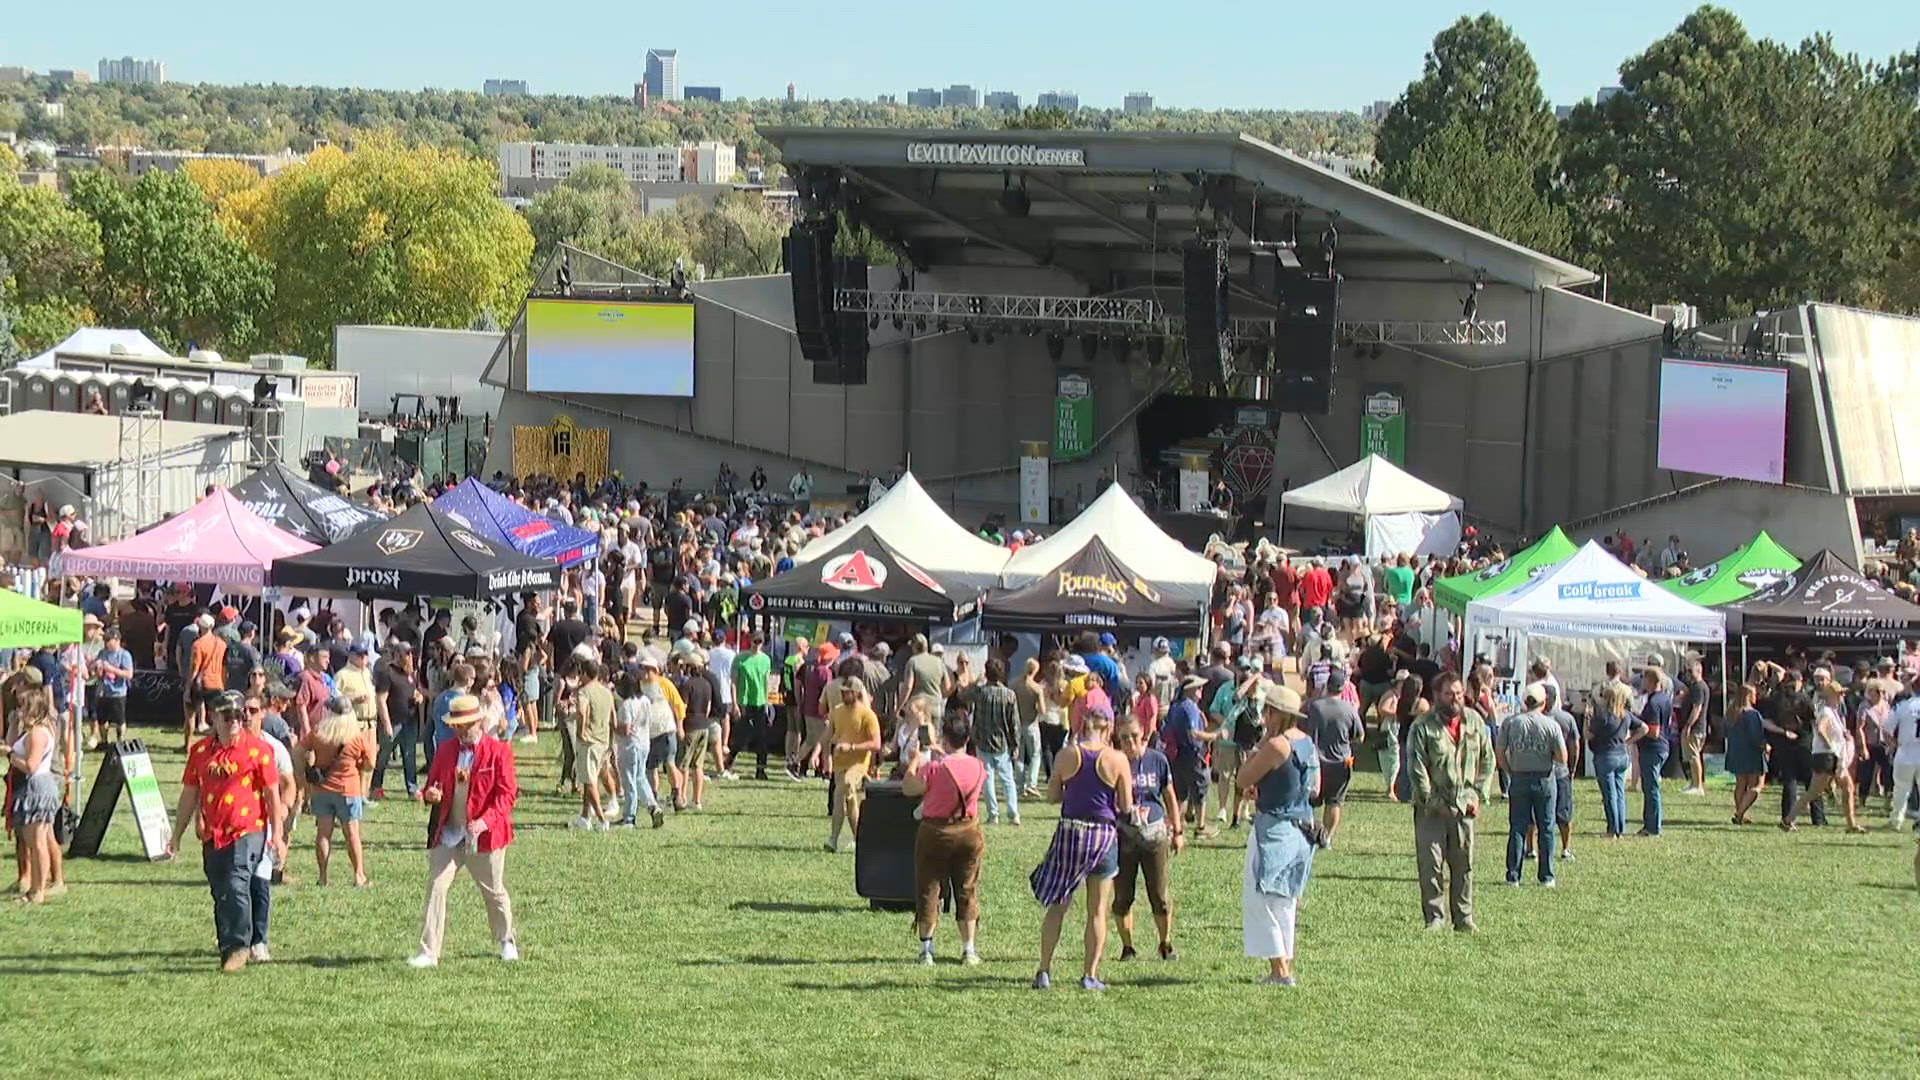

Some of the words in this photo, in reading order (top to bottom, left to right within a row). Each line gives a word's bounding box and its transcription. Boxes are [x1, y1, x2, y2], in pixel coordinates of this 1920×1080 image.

[908, 143, 958, 164] LEVITT
[958, 144, 1037, 166] PAVILION
[1036, 149, 1085, 166] DENVER
[1060, 409, 1075, 419] THE
[1060, 419, 1078, 430] MILE
[1368, 430, 1384, 440] THE
[1368, 440, 1389, 451] MILE
[66, 558, 131, 573] BROKEN
[136, 561, 181, 577] HOPS
[186, 564, 261, 583] BREWING
[1057, 570, 1129, 605] Founders
[1804, 575, 1876, 598] WESTBOUND
[767, 597, 789, 608] BEER
[790, 598, 816, 609] FIRST.
[818, 601, 833, 610] THE
[835, 601, 856, 611] REST
[857, 602, 877, 613] WILL
[878, 604, 914, 615] FOLLOW.
[1064, 613, 1092, 625] BREWED
[1806, 616, 1864, 627] WESTBOUND
[1880, 618, 1909, 628] DOWN
[13, 620, 59, 635] ANDERSEN
[1532, 620, 1546, 631] We
[1546, 621, 1569, 632] lower
[1631, 623, 1647, 632] Not
